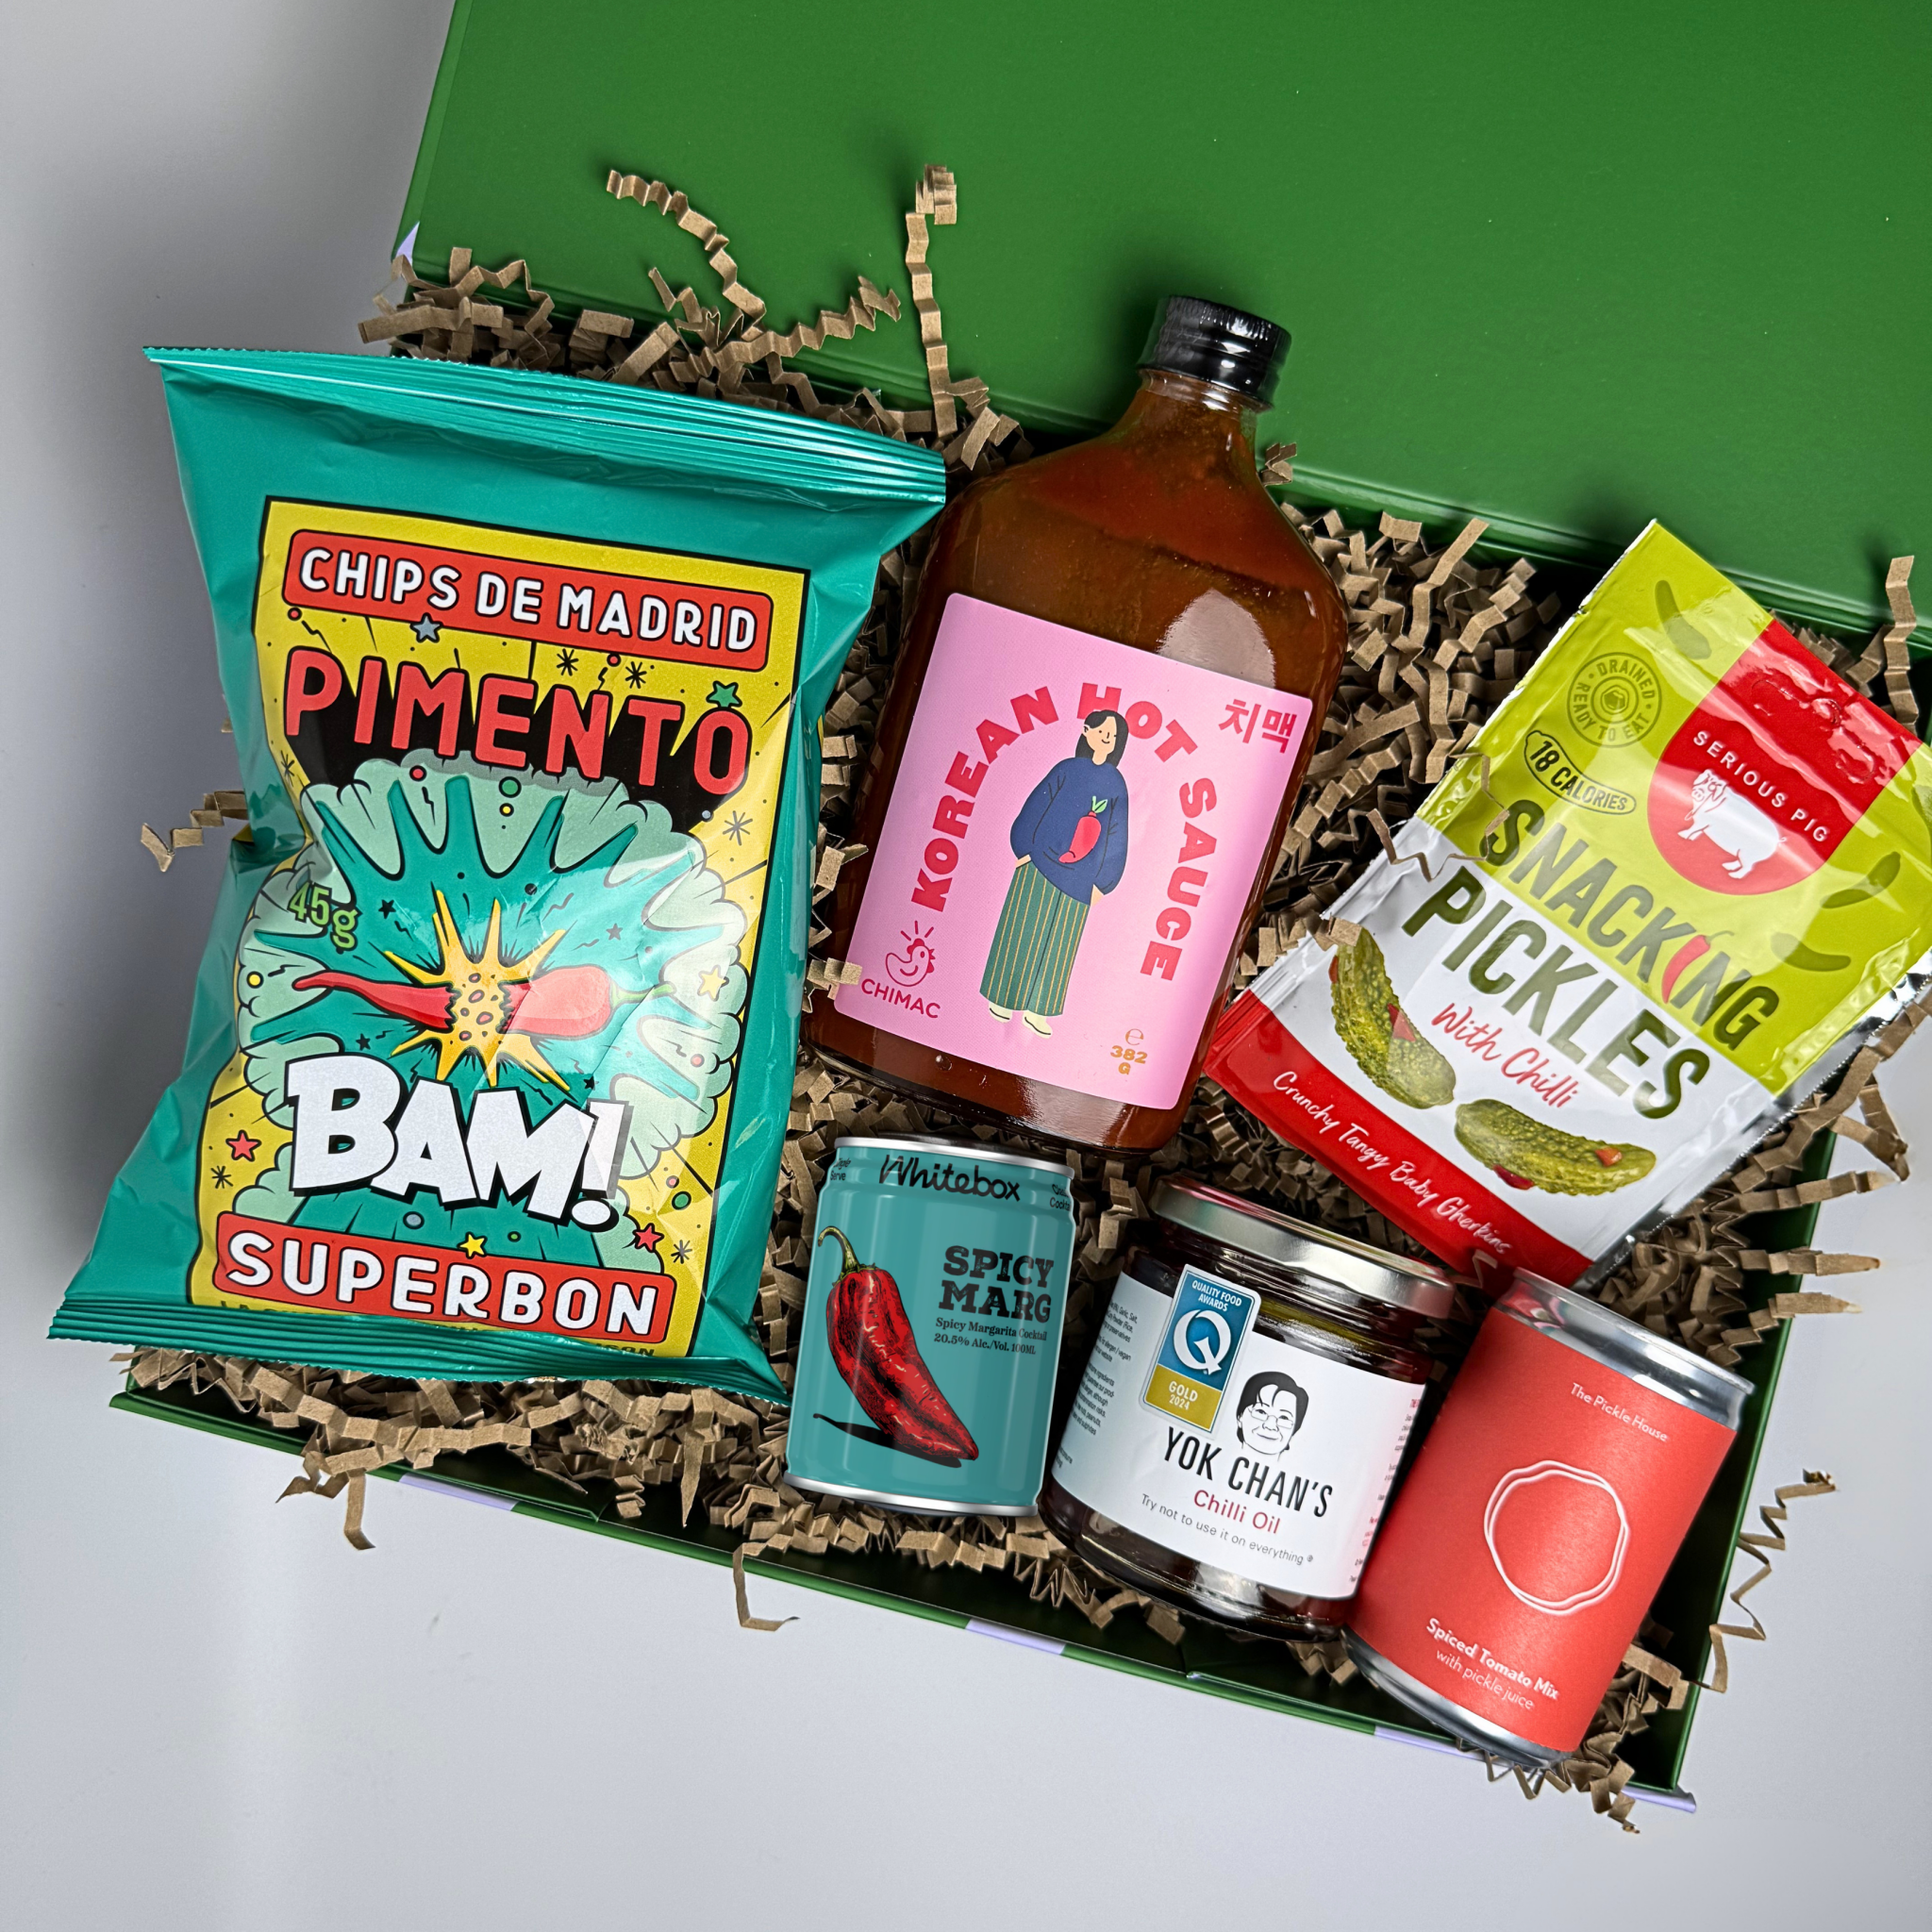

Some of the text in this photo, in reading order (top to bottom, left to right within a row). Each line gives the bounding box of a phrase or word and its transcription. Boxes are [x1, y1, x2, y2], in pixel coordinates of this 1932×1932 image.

[299, 547, 758, 652] CHIPS DE MADRID
[1596, 659, 1656, 699] DRAINED
[286, 648, 751, 795] PIMENTO
[1218, 699, 1297, 754] 치맥
[1574, 682, 1649, 741] READY TO EAT
[1529, 740, 1629, 811] 18 CALORIES
[1692, 730, 1829, 843] SERIOUS PIG
[910, 682, 1218, 981] KOREAN HOT SAUCE
[289, 882, 357, 950] 45g
[860, 977, 941, 1020] CHIMAC
[1401, 865, 1710, 1120] PICKLES
[1110, 1045, 1148, 1064] 382
[1431, 1002, 1580, 1109] With Chilli
[286, 1054, 627, 1229] BAM!
[1274, 1071, 1512, 1255] Crunchy Tangy Baby Gherkins
[878, 1154, 1021, 1202] Whitebox
[227, 1232, 658, 1335] SUPERBON
[943, 1245, 1054, 1288] SPICY
[1191, 1280, 1242, 1307] QUALITY FOOD
[936, 1317, 1047, 1341] Spicy Margarita Cocktail
[939, 1280, 1052, 1323] MARG
[1198, 1293, 1228, 1311] AWARDS
[934, 1333, 1036, 1355] 20.5% Alc./Vol. 100ML
[1169, 1380, 1198, 1402] GOLD
[1169, 1394, 1191, 1410] 2024
[1570, 1382, 1669, 1442] The Pickle House
[1164, 1425, 1333, 1518] YOK CHAN'S
[1141, 1493, 1158, 1511] Try
[1159, 1504, 1178, 1521] not
[1181, 1513, 1193, 1526] to
[1196, 1520, 1217, 1536] use
[1220, 1528, 1229, 1541] it
[1231, 1535, 1246, 1547] on
[1193, 1490, 1281, 1534] Chilli Oil
[1426, 1617, 1558, 1699] Spiced Tomato Mix
[1436, 1650, 1534, 1710] with pickle juice
